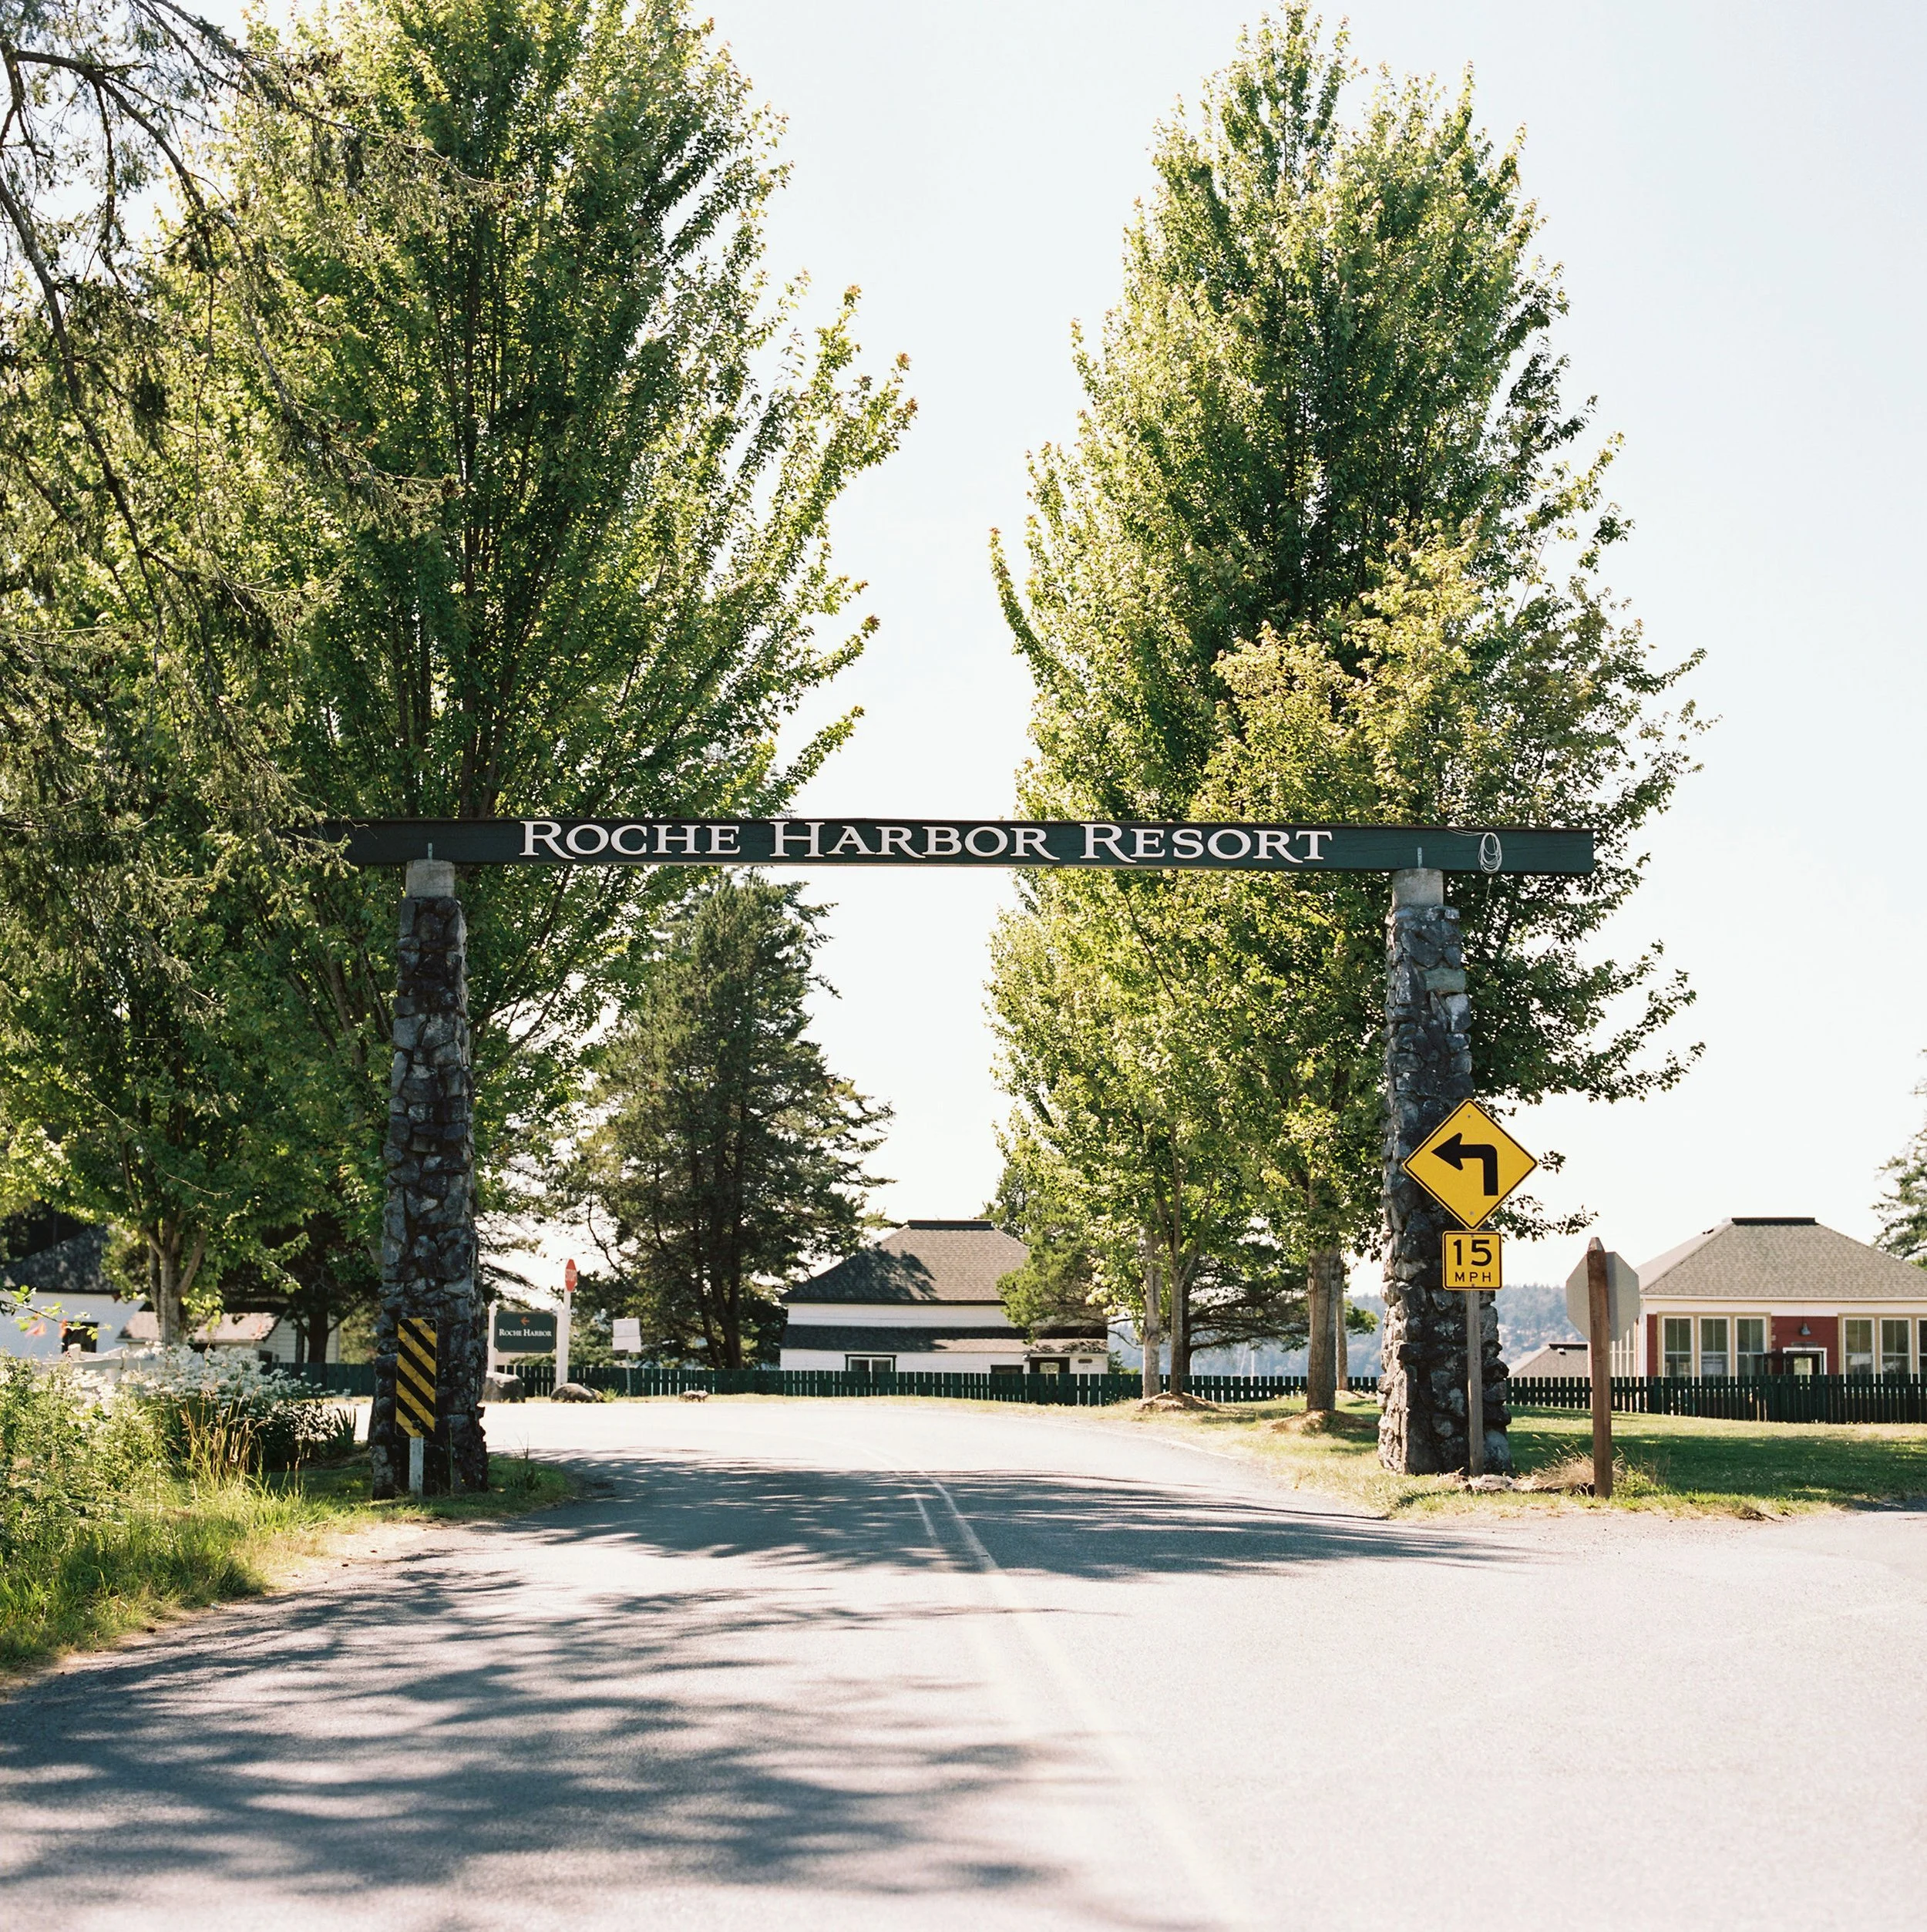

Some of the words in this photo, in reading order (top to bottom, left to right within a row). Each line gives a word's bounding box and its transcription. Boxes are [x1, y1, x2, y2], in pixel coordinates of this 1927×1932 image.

[519, 820, 741, 860] ROCHE
[769, 822, 1061, 860] HARBOR
[1079, 823, 1333, 863] RESORT
[1453, 1239, 1492, 1267] 15
[1454, 1272, 1491, 1282] MPH
[499, 1328, 522, 1337] ROCHE
[523, 1328, 552, 1337] HARBOR
